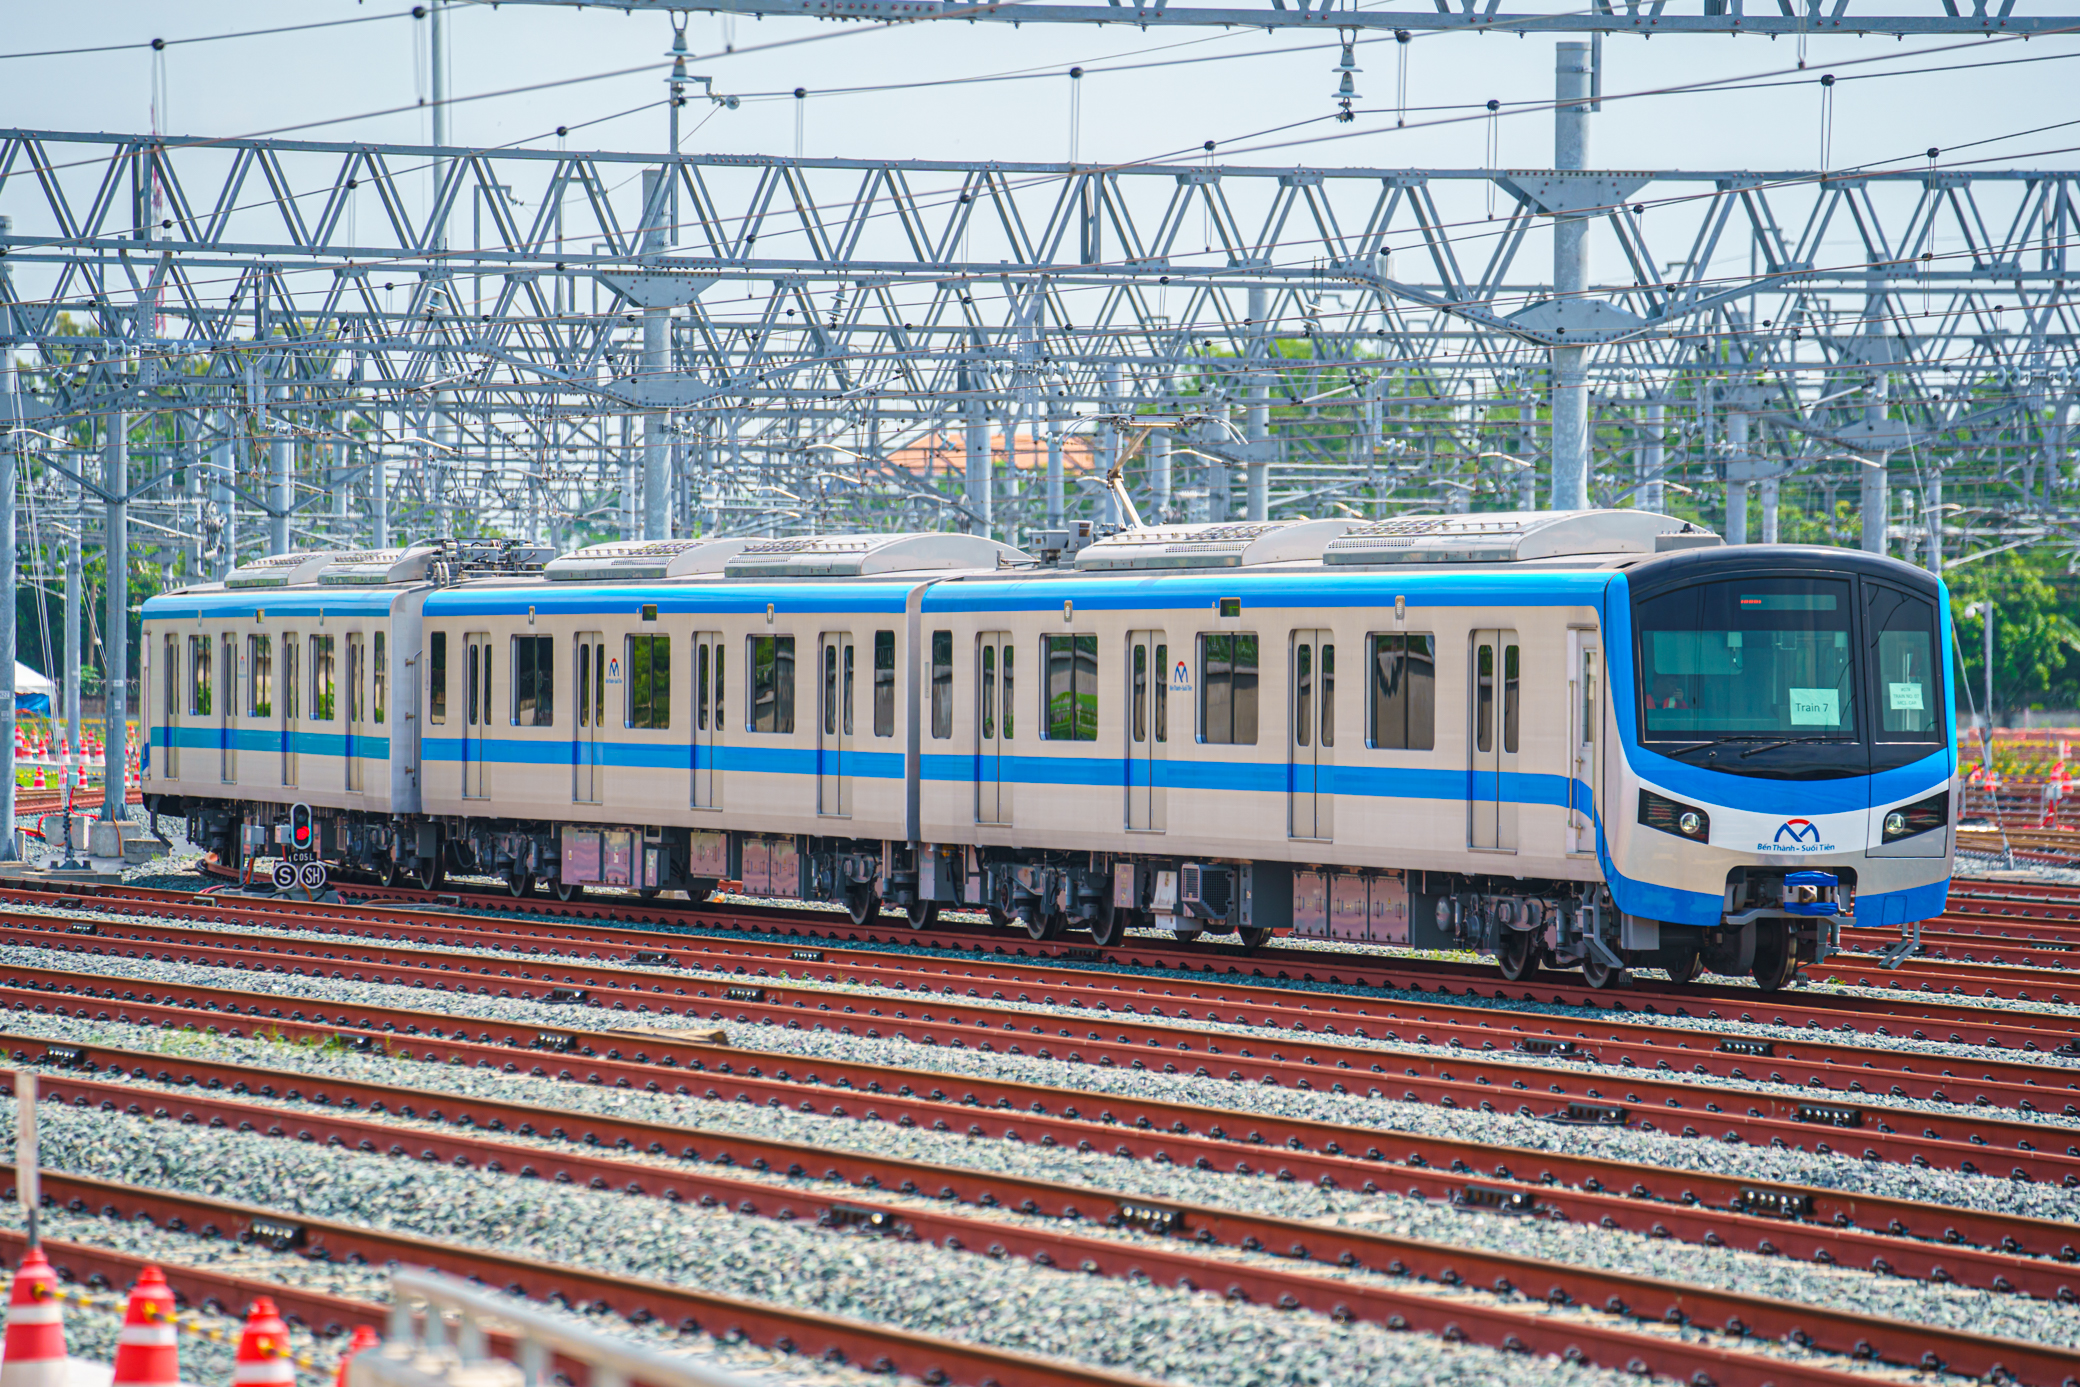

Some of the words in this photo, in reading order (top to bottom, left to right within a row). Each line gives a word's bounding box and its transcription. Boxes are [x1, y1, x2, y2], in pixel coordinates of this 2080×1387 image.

[1795, 702, 1820, 712] Train
[1823, 702, 1829, 712] 7
[1757, 843, 1772, 851] Bến
[1773, 844, 1796, 852] Thành
[1801, 843, 1818, 852] Suối
[1819, 843, 1835, 851] Tiên
[279, 867, 291, 884] S
[305, 867, 320, 884] SH
